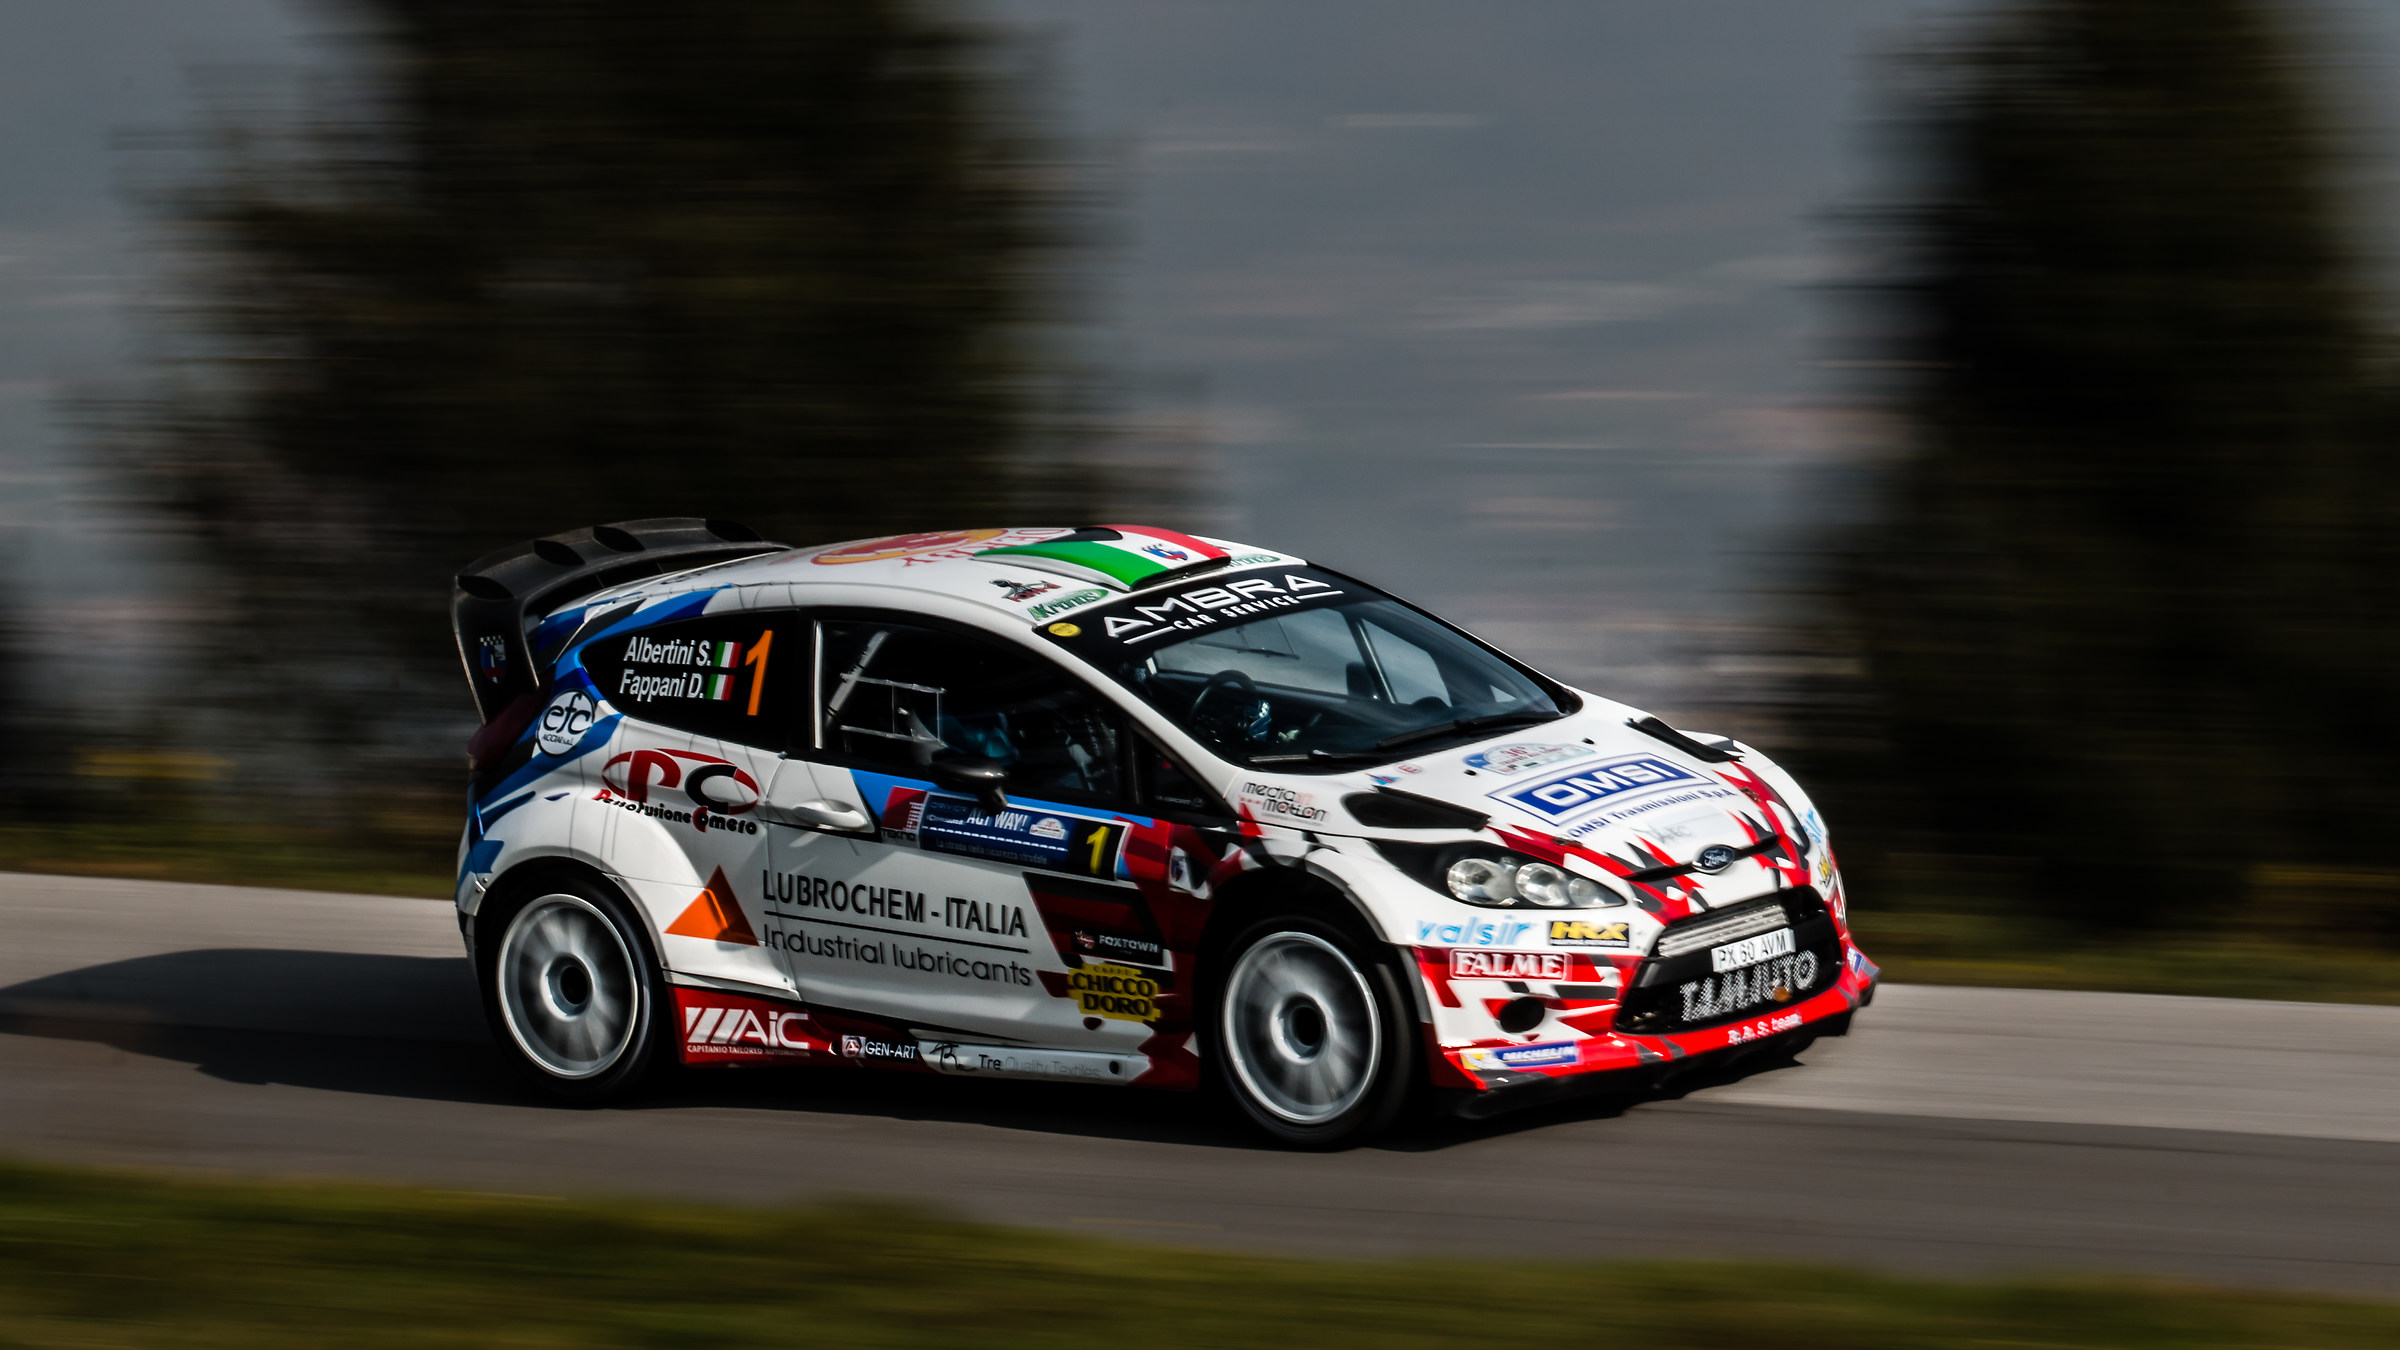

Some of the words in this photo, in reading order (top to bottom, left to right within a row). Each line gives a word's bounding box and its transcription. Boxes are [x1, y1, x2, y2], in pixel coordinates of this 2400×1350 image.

[1104, 574, 1331, 638] AMBRA
[1171, 613, 1218, 631] CAR
[1220, 595, 1300, 618] SERVICE
[623, 636, 693, 665] Albertini
[696, 640, 712, 666] S.
[619, 670, 687, 702] Fappani
[687, 674, 704, 698] D.
[745, 630, 774, 716] 1
[544, 693, 591, 735] efc
[1531, 760, 1680, 807] OMSI
[994, 810, 1028, 832] WAY!
[1570, 816, 1612, 838] OMSI
[1606, 789, 1701, 820] Trasmissioni
[1086, 825, 1111, 875] 1
[762, 869, 924, 923] LUBROCHEM
[945, 897, 1030, 938] ITALIA
[1099, 934, 1158, 953] FOXTOWN
[1416, 915, 1531, 945] valsir
[1550, 921, 1628, 941] HRX
[763, 924, 886, 966] Industrial
[893, 943, 1033, 987] lubricants
[1718, 949, 1736, 967] PX
[1741, 941, 1755, 962] 60
[1762, 931, 1787, 956] AVM
[1455, 952, 1564, 979] FALME
[1072, 972, 1153, 997] CHICCO
[864, 1041, 916, 1059] GEN-ART
[978, 1054, 1001, 1070] Tre
[1502, 1045, 1577, 1061] MICHELIN
